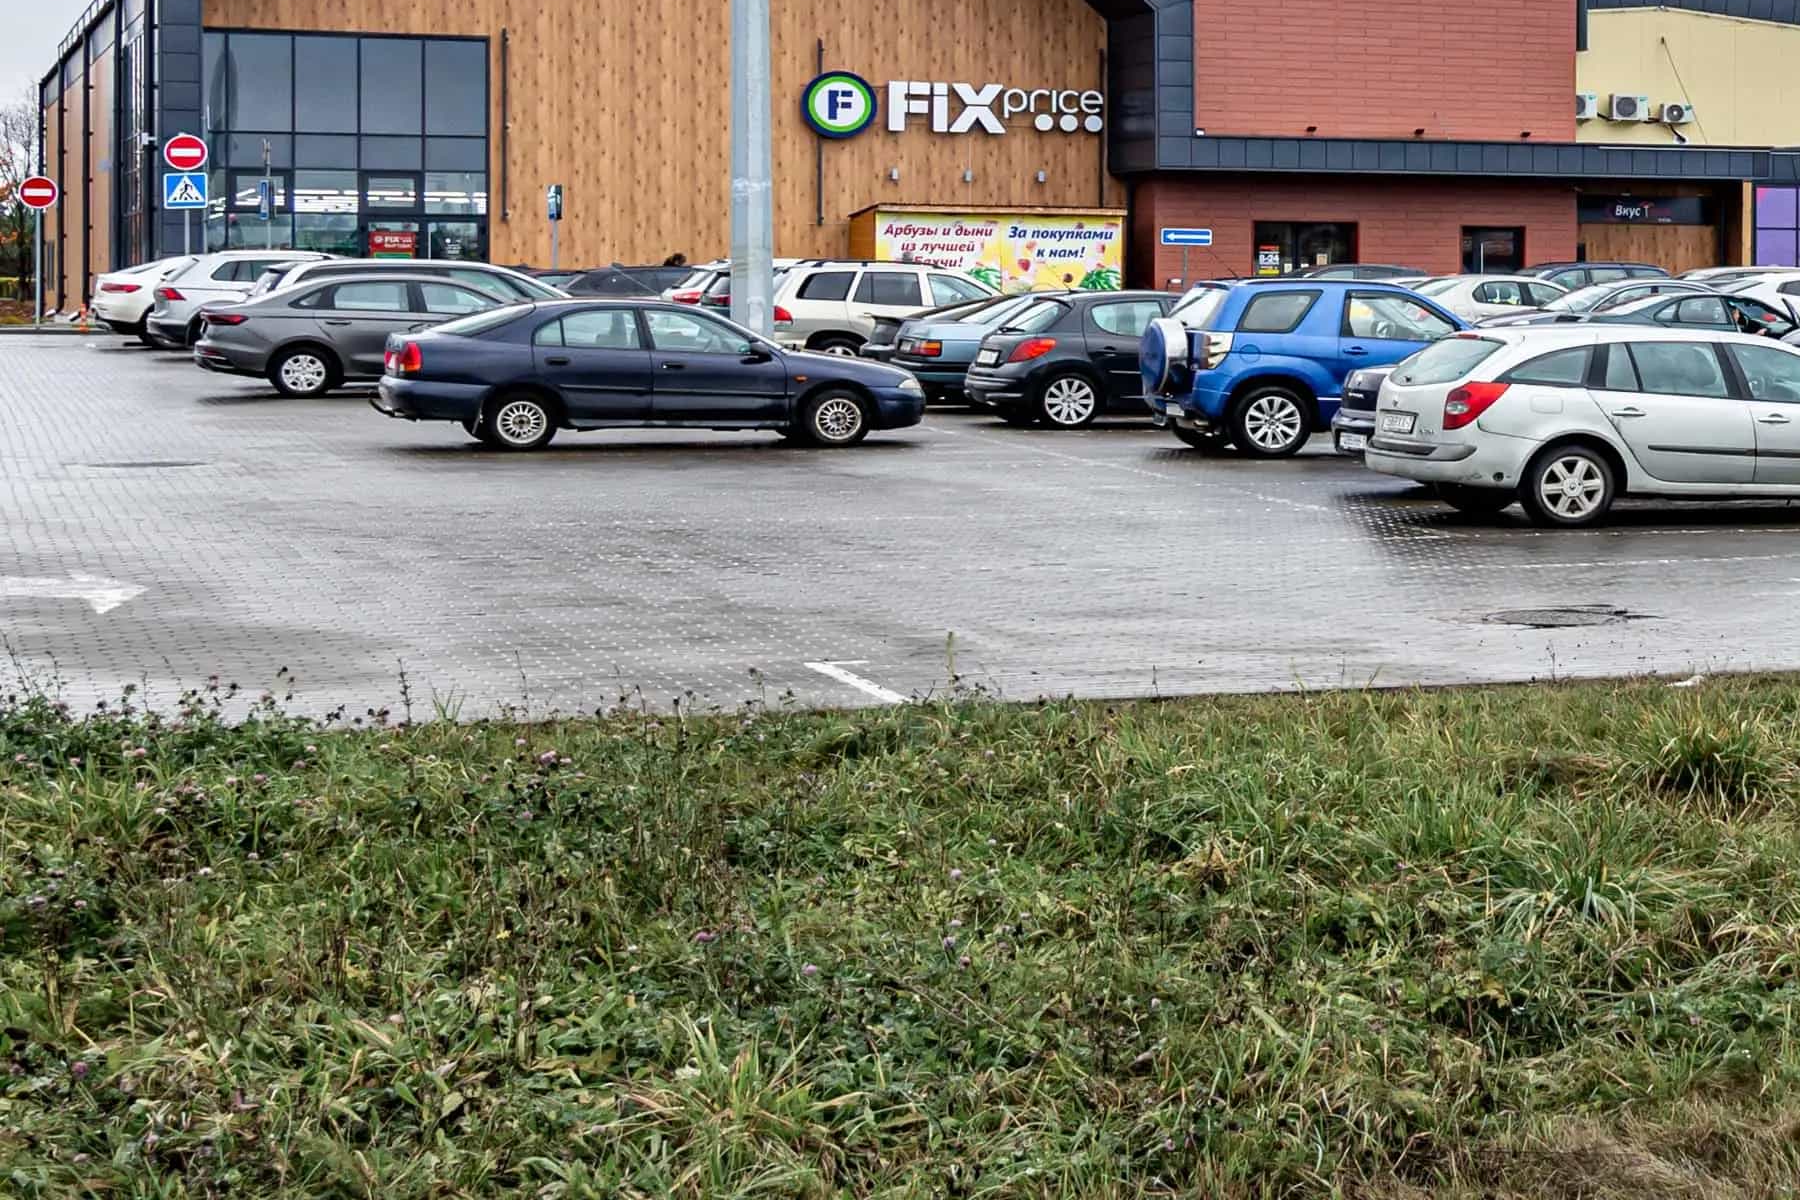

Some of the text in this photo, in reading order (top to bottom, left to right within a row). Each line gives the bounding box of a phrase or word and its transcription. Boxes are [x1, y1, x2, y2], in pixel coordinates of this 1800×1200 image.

[1003, 87, 1104, 119] price
[1615, 204, 1641, 219] Вкус
[884, 223, 994, 237] Арбузы и дыни
[1008, 226, 1114, 241] За покупками
[901, 241, 976, 253] из лучшей
[1036, 246, 1086, 259] к нам!
